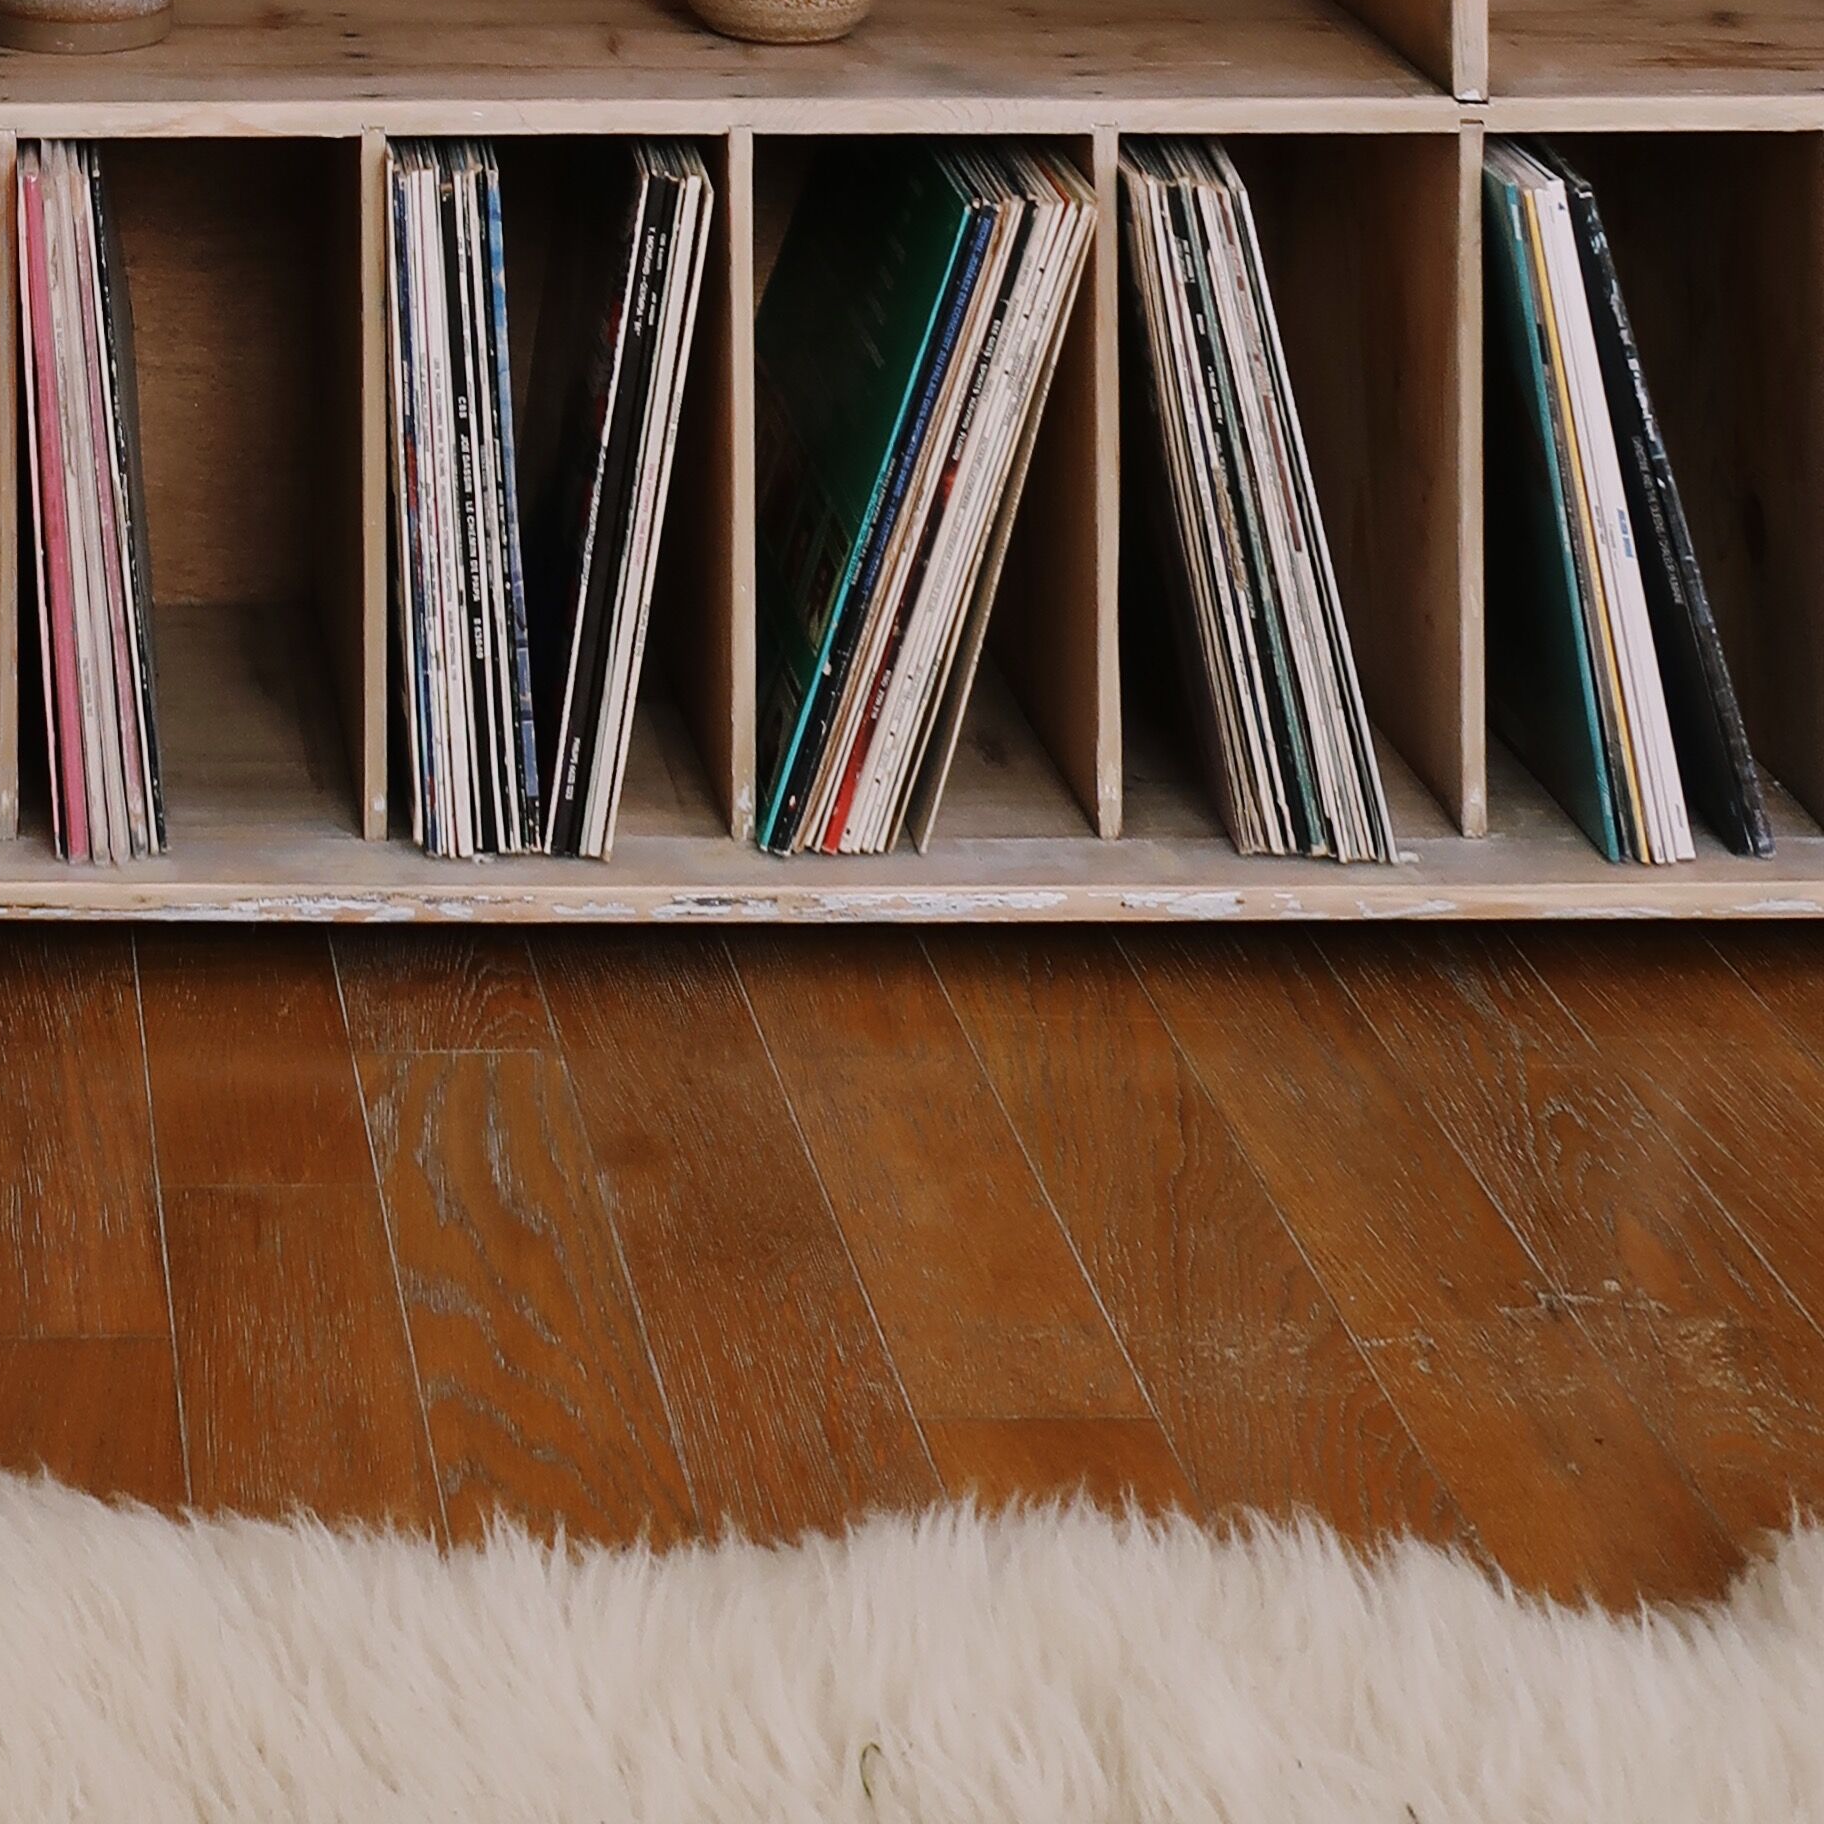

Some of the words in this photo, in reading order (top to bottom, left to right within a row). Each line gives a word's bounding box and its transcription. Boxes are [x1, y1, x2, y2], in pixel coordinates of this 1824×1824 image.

[457, 395, 468, 419] CBS
[460, 433, 471, 454] JOE
[461, 453, 473, 494] DASSIN
[464, 500, 475, 514] LE
[466, 514, 478, 558] CHEMIN
[469, 559, 479, 574] DE
[471, 574, 481, 602] PAPA
